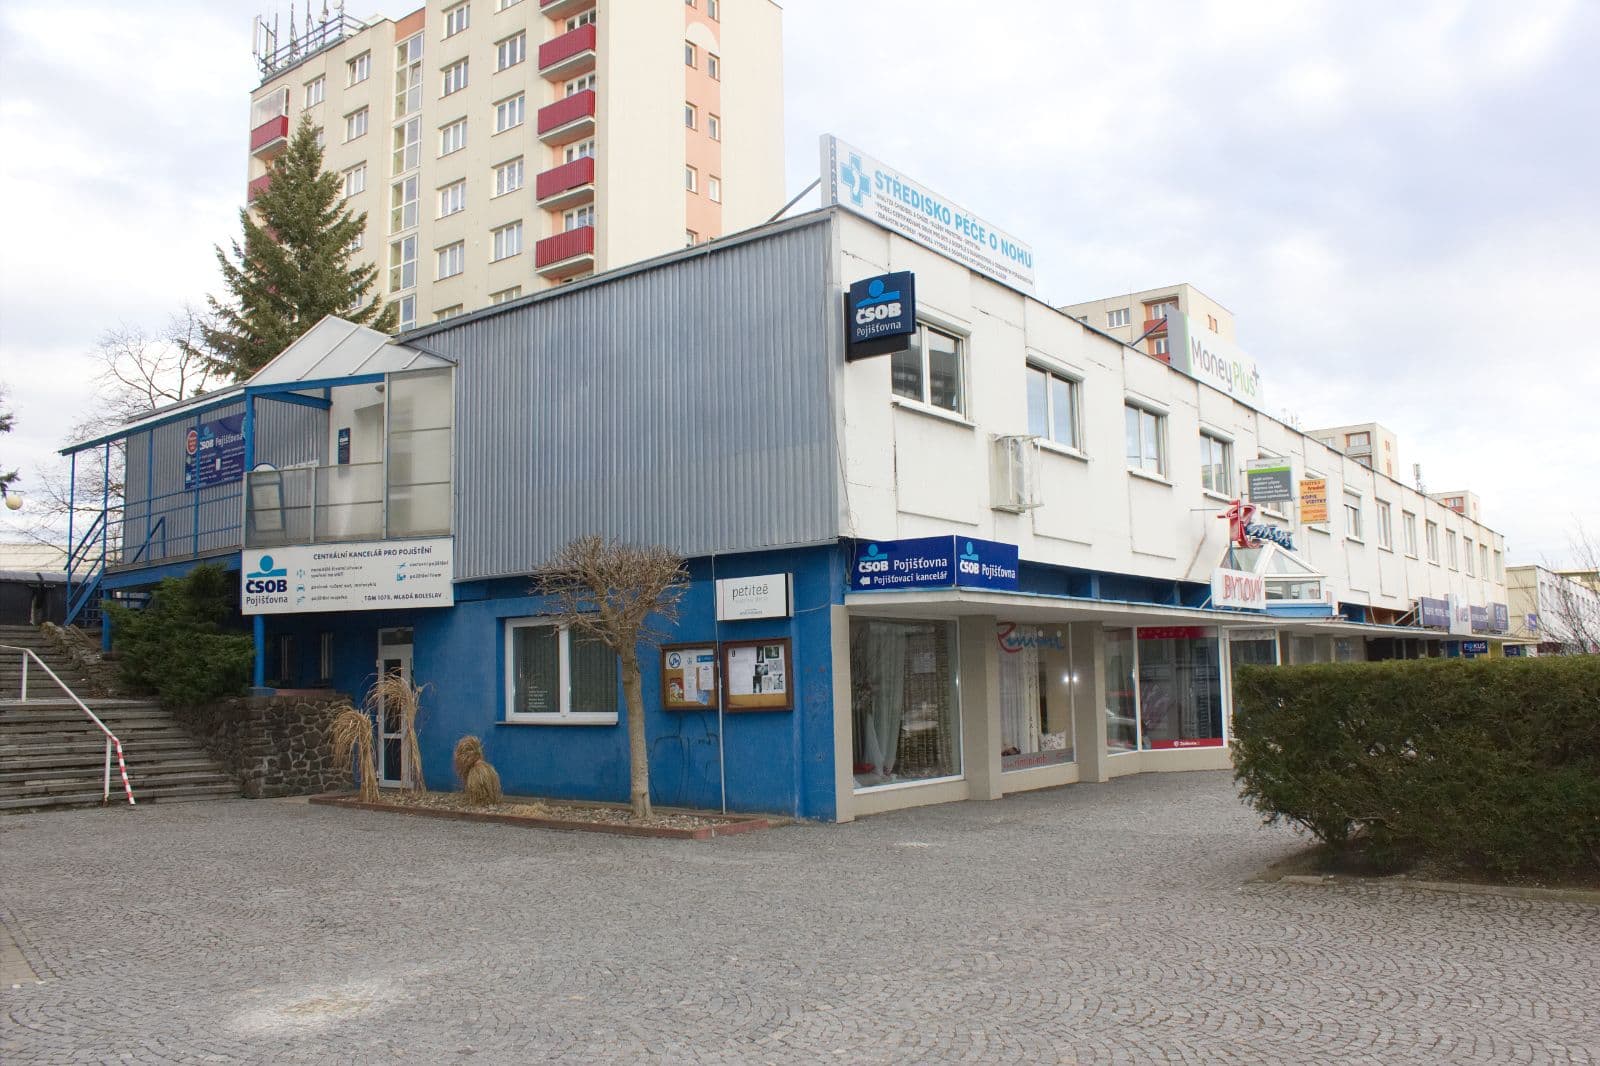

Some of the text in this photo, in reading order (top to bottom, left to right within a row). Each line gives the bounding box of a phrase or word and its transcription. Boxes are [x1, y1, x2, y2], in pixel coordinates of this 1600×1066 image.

[874, 169, 951, 225] STŘEDISKO
[955, 211, 987, 244] PÉČE
[989, 232, 998, 250] O
[1001, 238, 1032, 269] NOHU
[856, 302, 901, 324] ČSOB
[856, 321, 901, 337] Pojišťovna
[313, 551, 348, 560] CENTRÁLNÍ
[349, 548, 382, 558] KANCELÁŘ
[399, 546, 432, 555] POJIŠTĚNÍ
[859, 557, 948, 573] ČSOB Pojišťovna
[959, 559, 1016, 579] ČSOB Pojišťovna
[245, 579, 288, 593] ČSOB
[873, 572, 948, 586] Pojišťovací kancelář
[246, 595, 288, 606] Pojišťovna
[394, 592, 413, 600] MLADÁ
